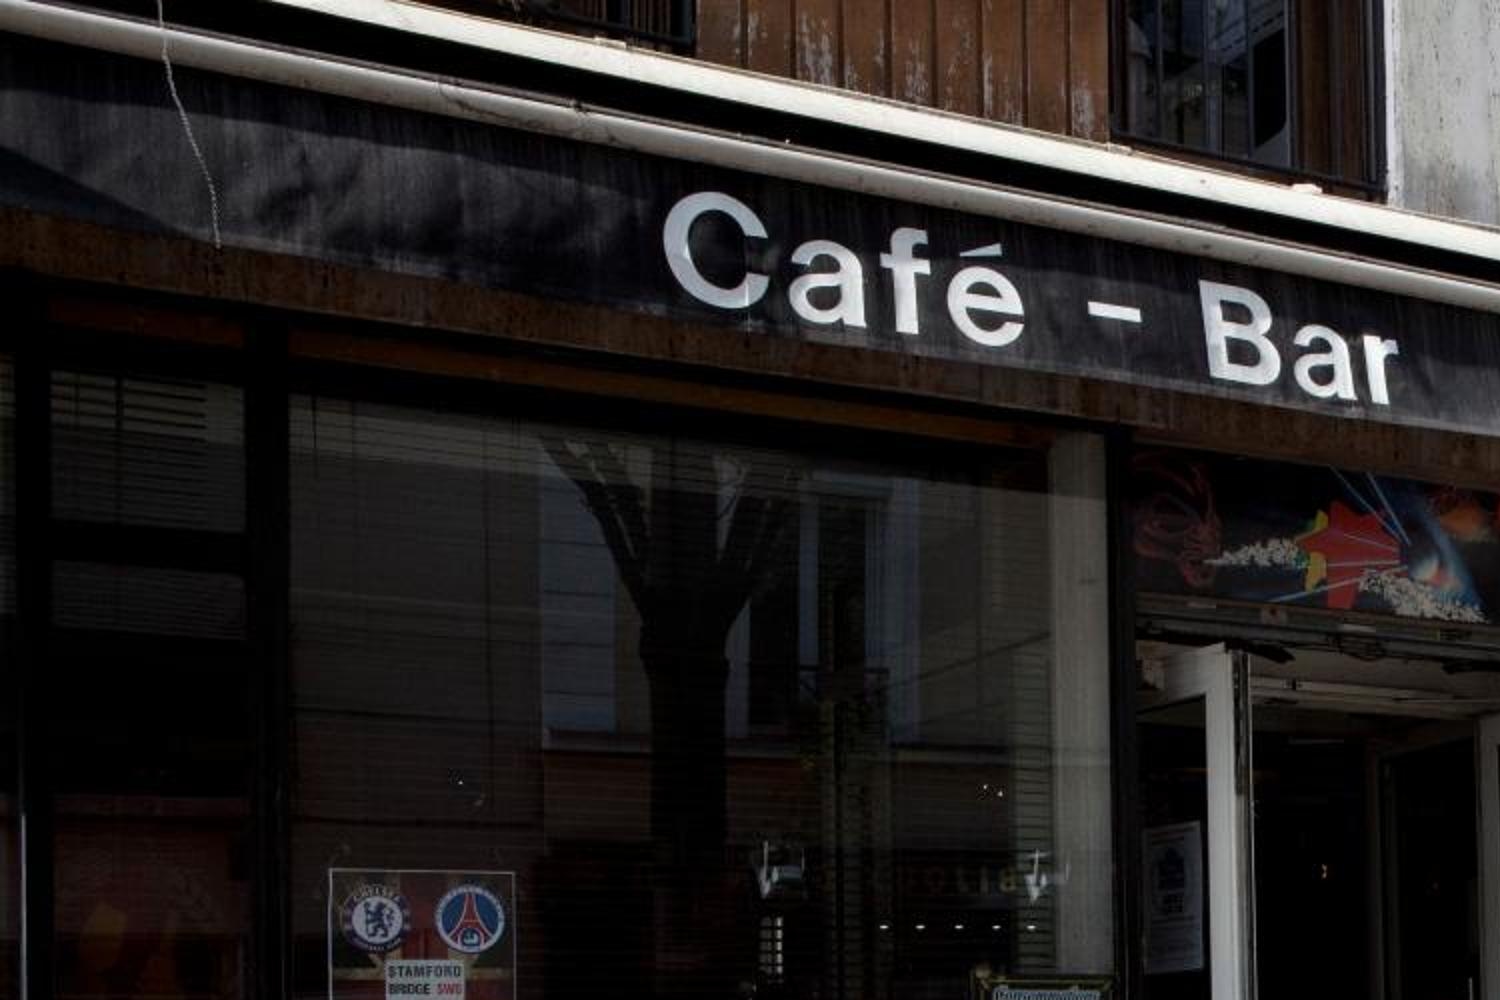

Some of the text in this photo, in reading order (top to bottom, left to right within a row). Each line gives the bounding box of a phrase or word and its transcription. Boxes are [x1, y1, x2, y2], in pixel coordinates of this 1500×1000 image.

[663, 190, 1026, 347] Café
[1199, 279, 1399, 405] Bar
[387, 964, 462, 978] STAMFORD
